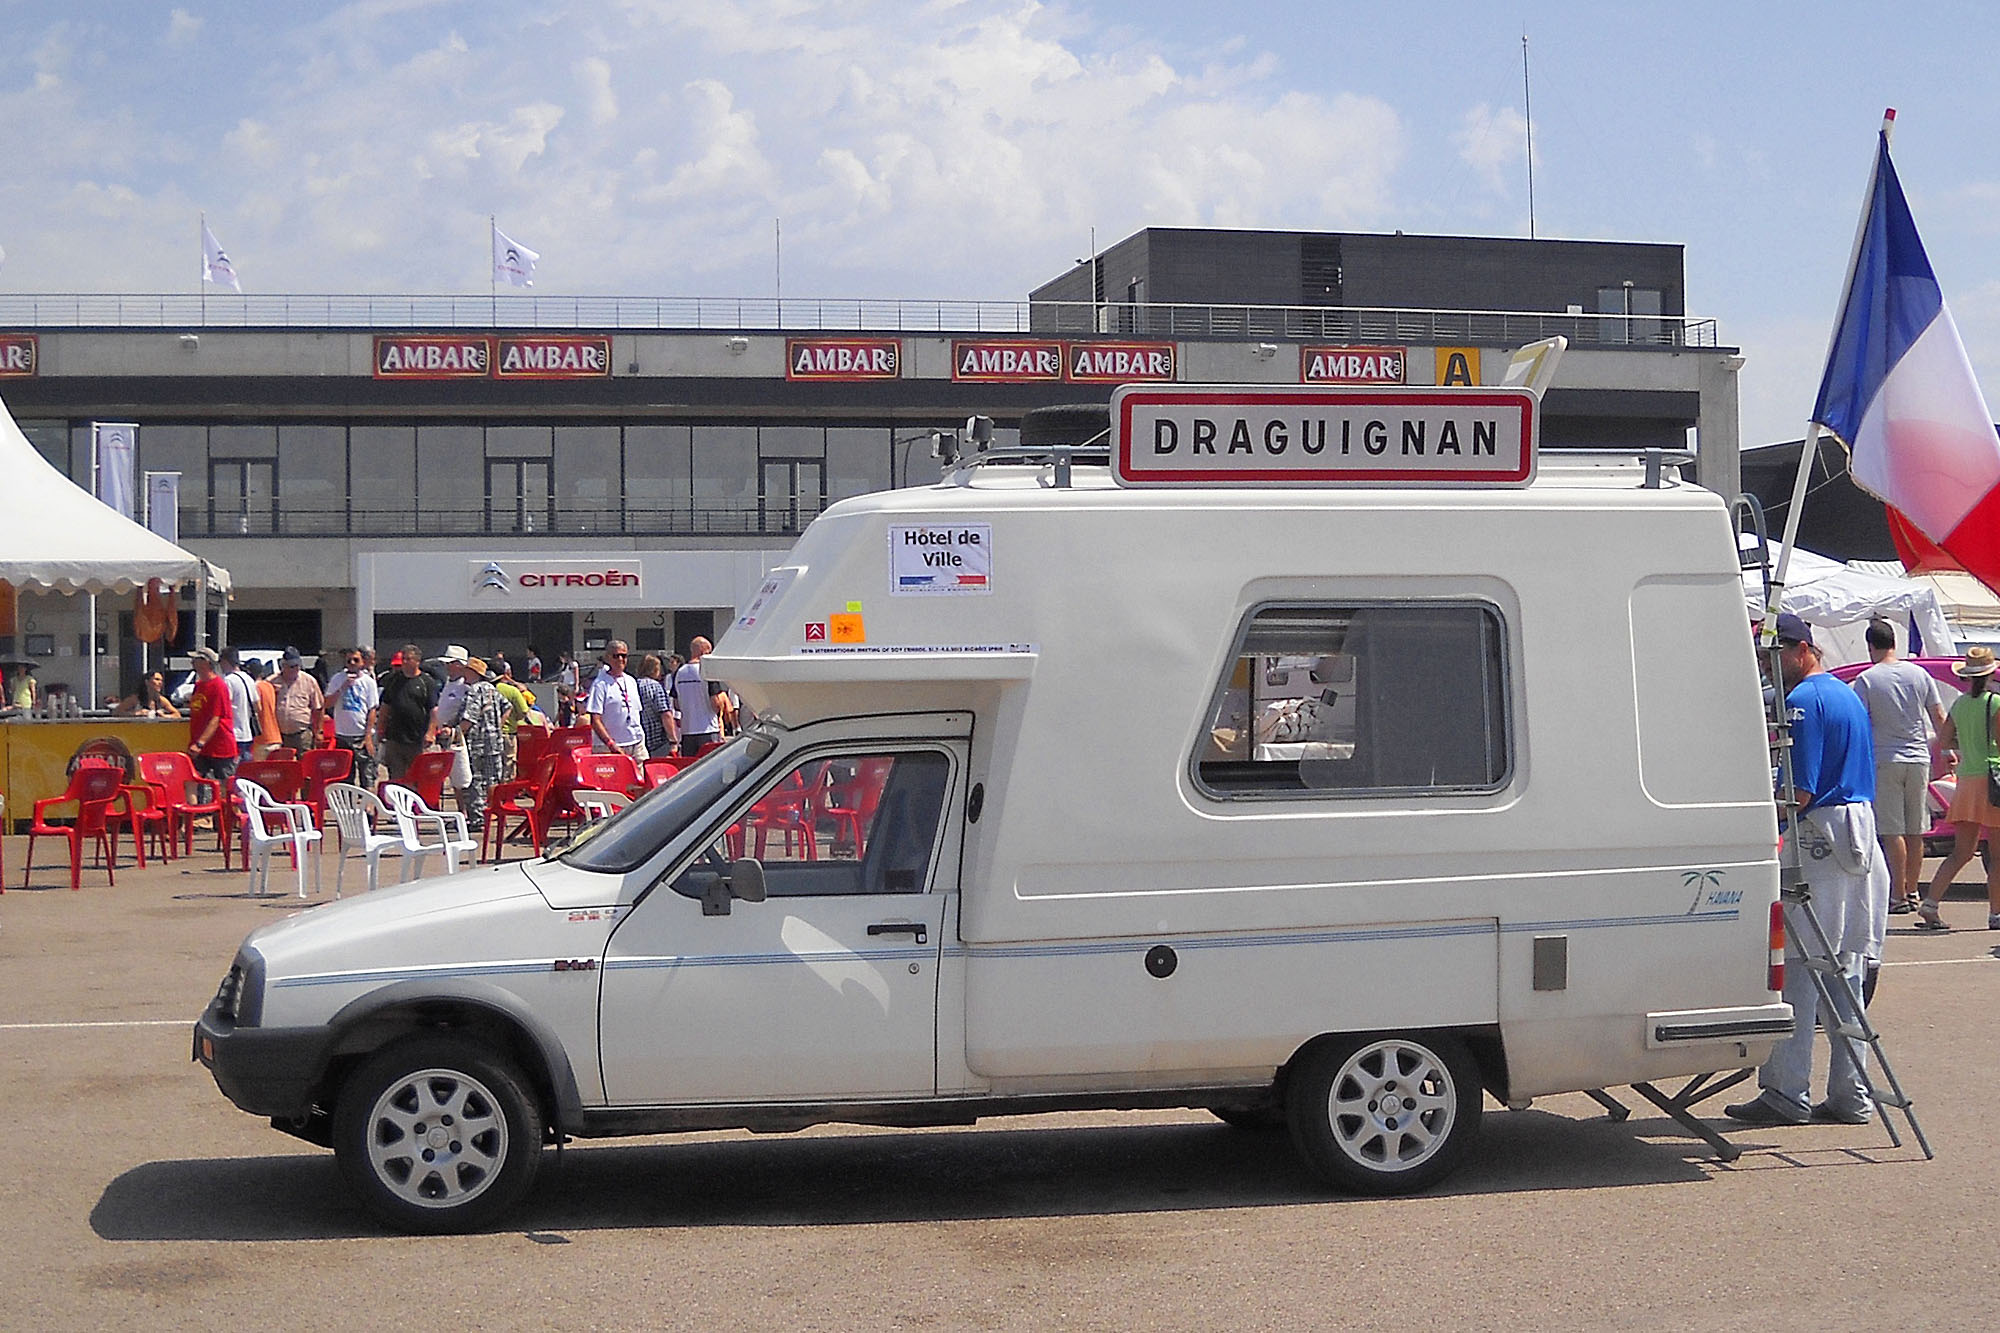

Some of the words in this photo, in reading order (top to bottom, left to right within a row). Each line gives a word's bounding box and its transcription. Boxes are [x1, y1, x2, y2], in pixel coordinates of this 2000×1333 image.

[382, 346, 482, 369] AMBAR
[503, 346, 600, 370] AMBAR
[795, 349, 891, 372] AMBAR
[960, 350, 1054, 375] AMBAR
[1074, 351, 1166, 375] AMBAR
[1308, 355, 1397, 379] AMBAR
[1443, 352, 1473, 386] A
[1154, 419, 1497, 456] DRAGUIGNAN
[958, 530, 980, 545] de
[922, 552, 962, 567] Ville
[584, 611, 596, 627] 4
[653, 611, 665, 627] 3
